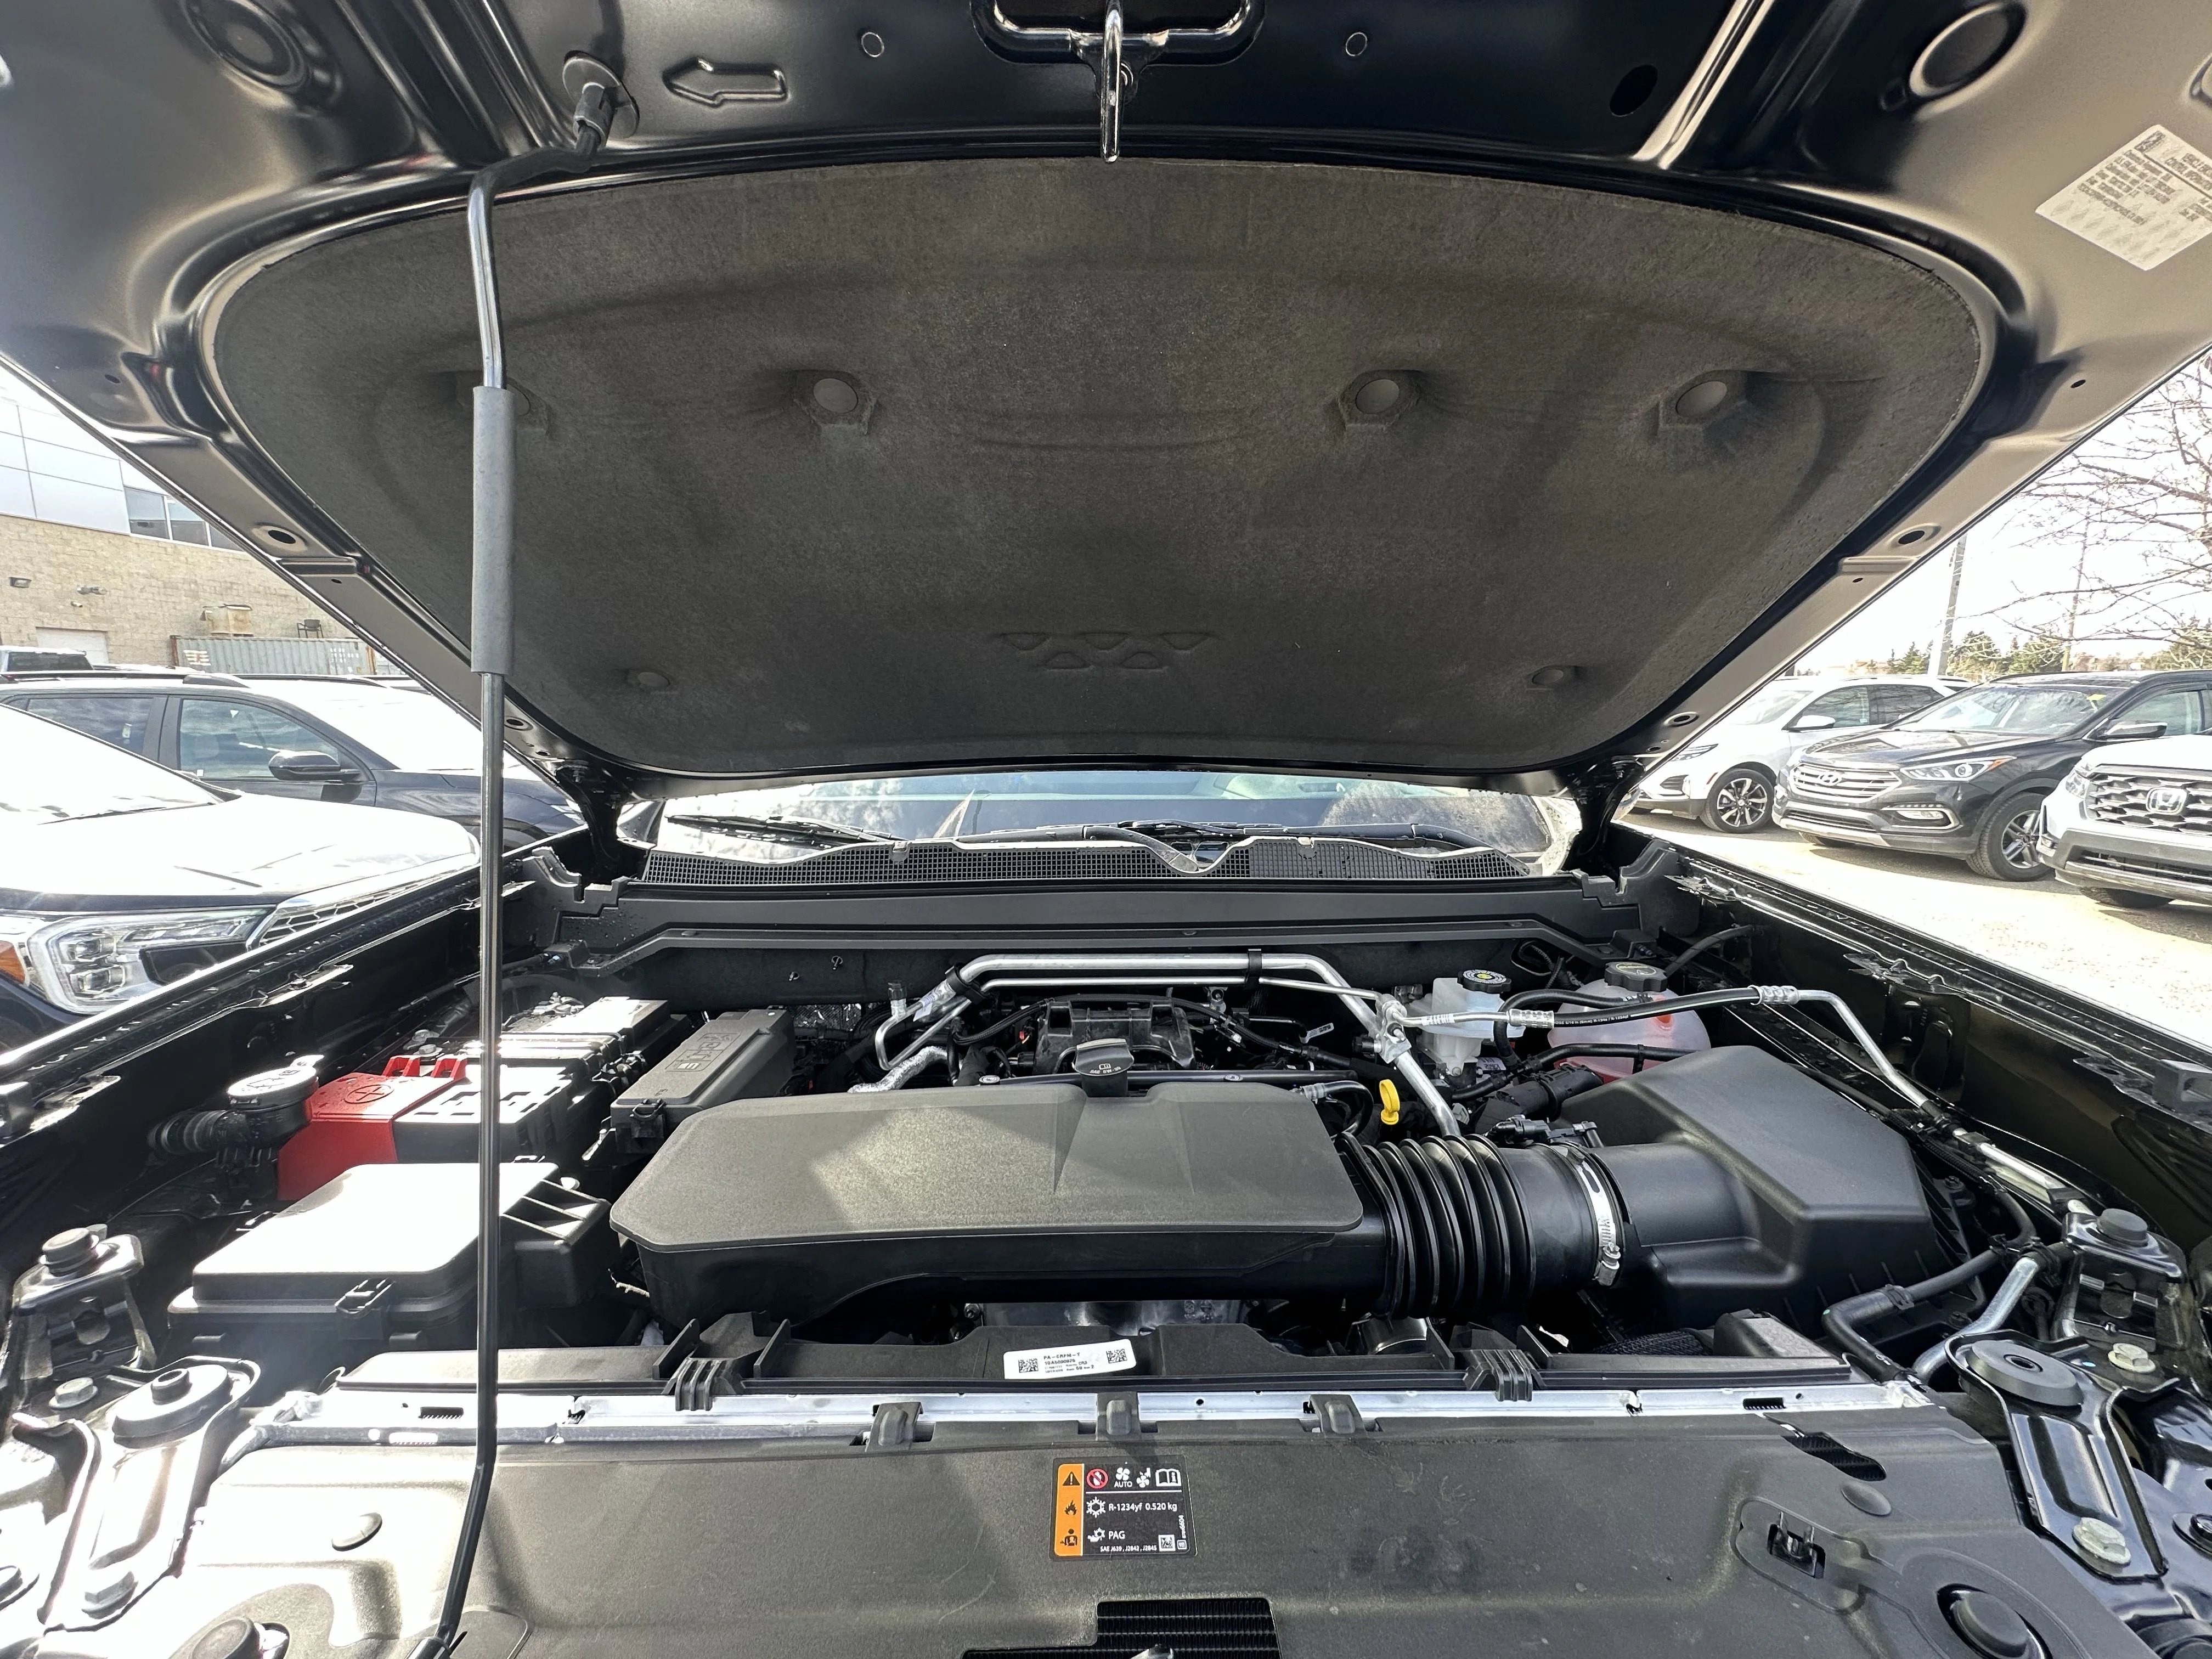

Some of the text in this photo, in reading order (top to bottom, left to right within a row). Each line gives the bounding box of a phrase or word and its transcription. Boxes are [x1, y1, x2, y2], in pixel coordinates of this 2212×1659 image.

[1108, 1503, 1143, 1513] R-1234yf
[1167, 1502, 1177, 1512] kg
[1108, 1530, 1125, 1540] PAG
